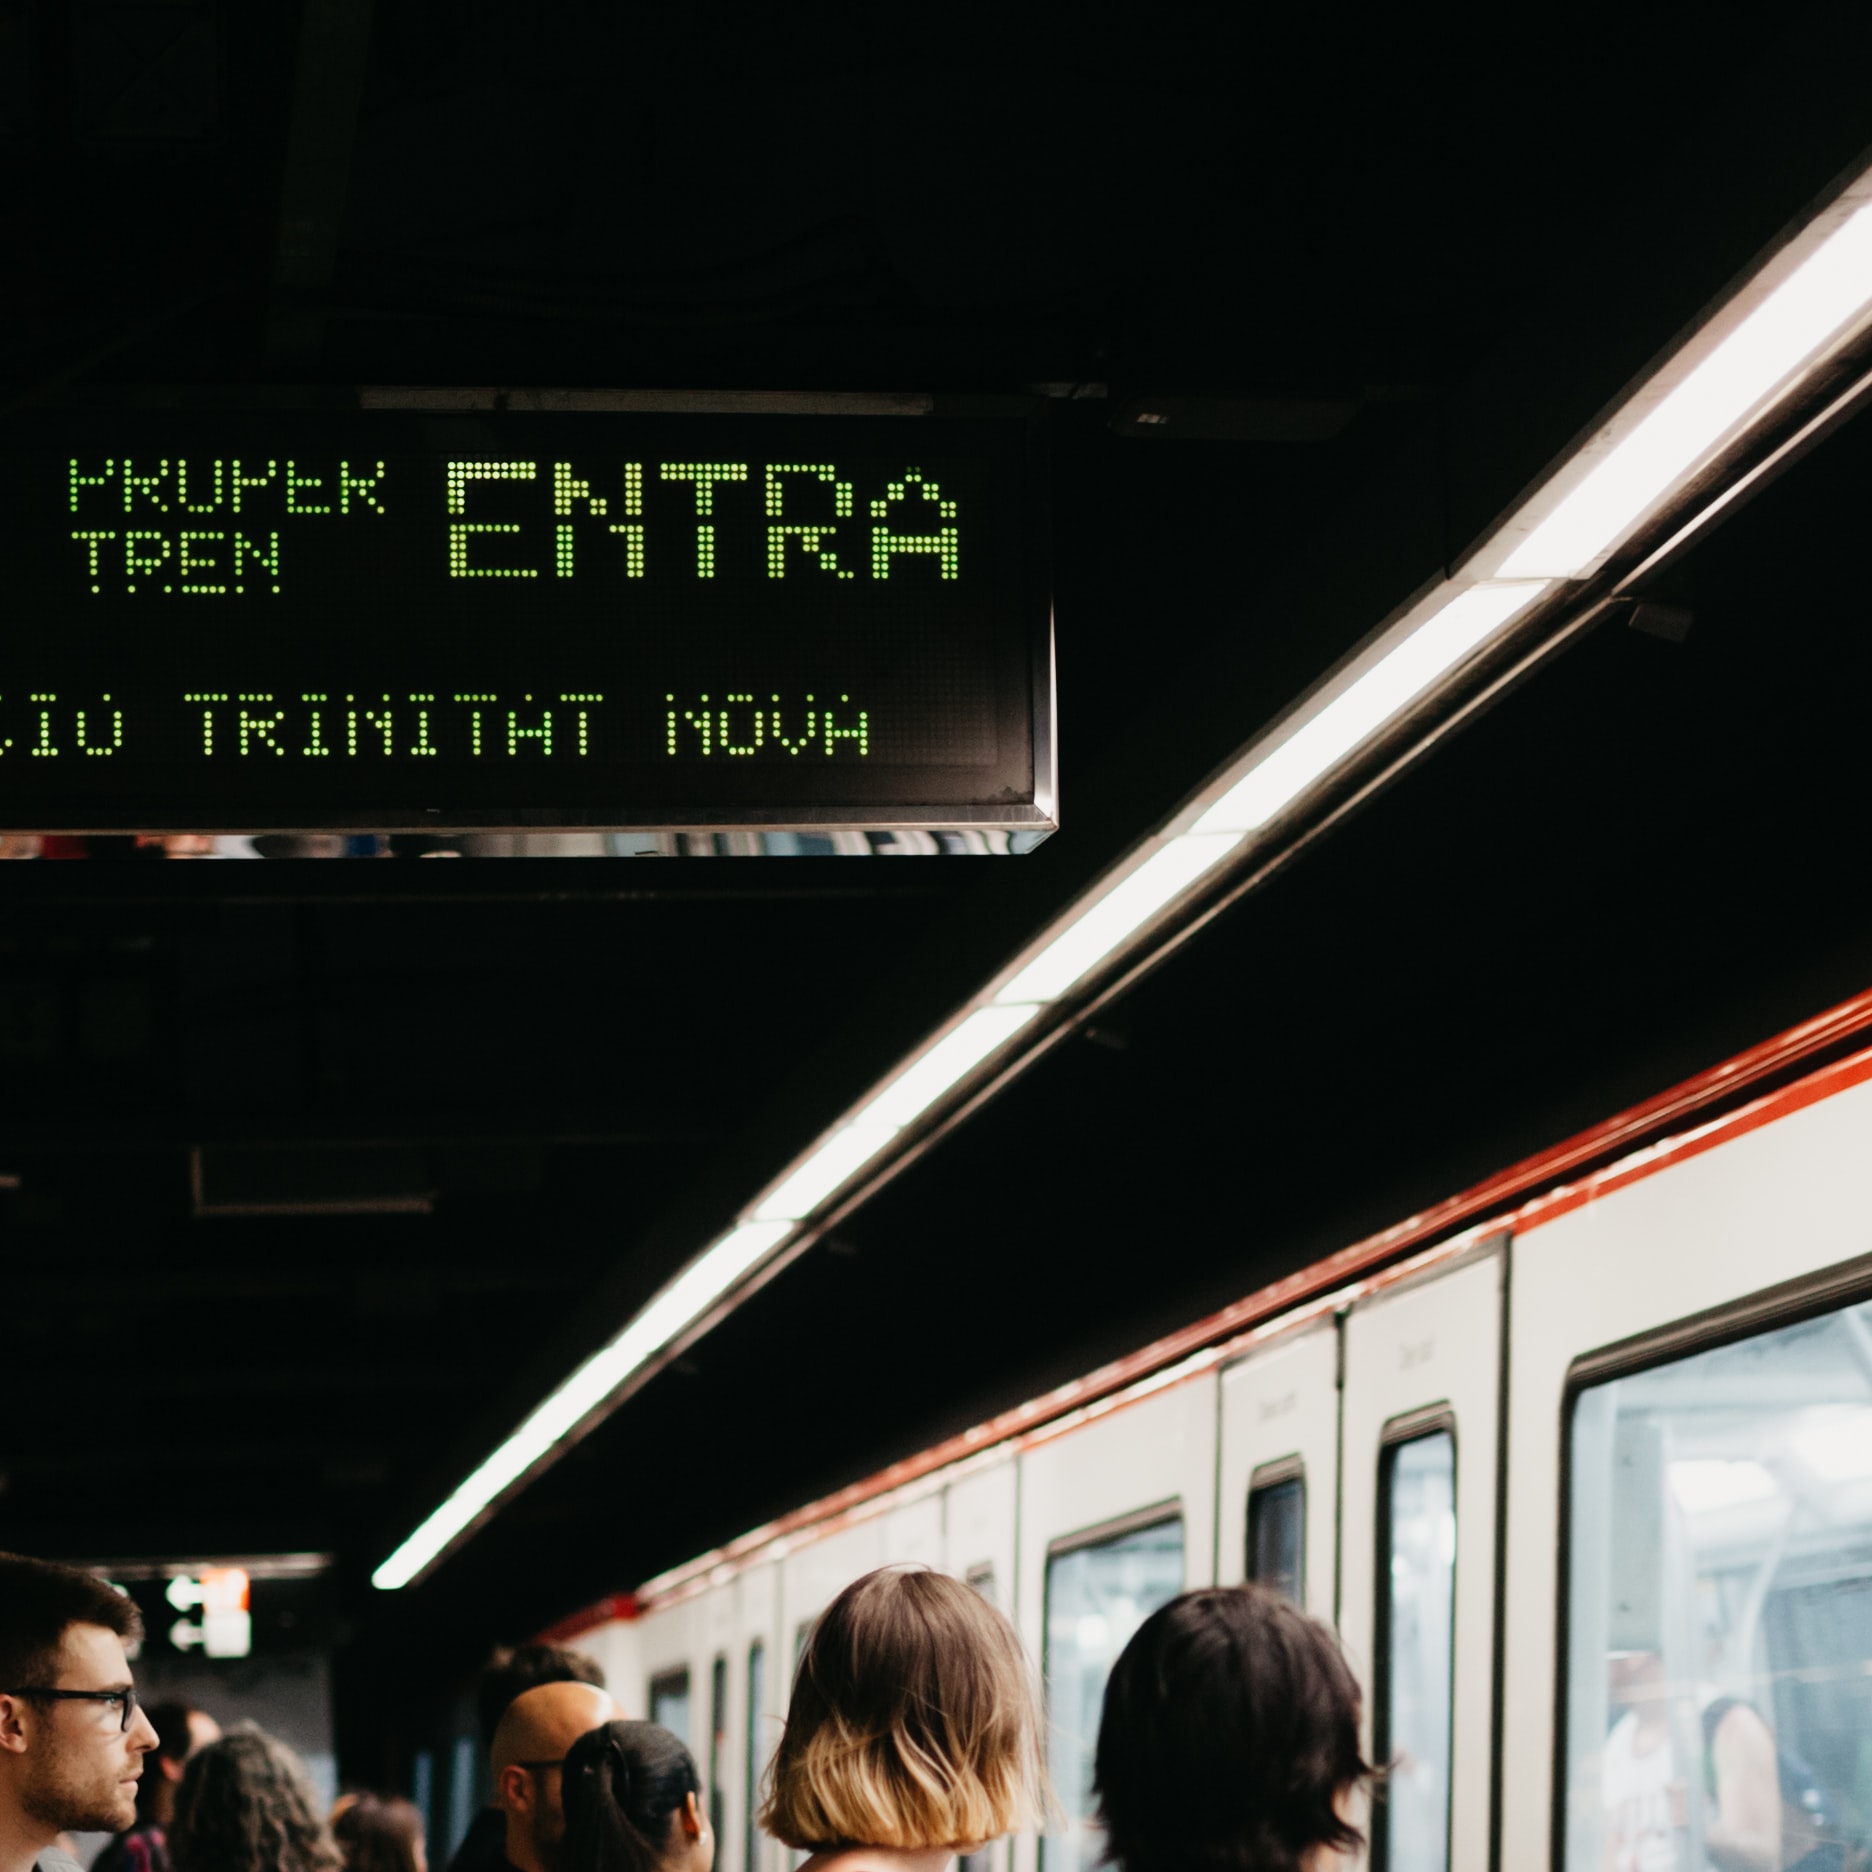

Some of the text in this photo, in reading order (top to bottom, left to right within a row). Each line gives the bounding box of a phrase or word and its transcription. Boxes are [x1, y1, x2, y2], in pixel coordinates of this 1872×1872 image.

[447, 462, 959, 580] ENTRA
[71, 531, 281, 594] TREN
[183, 693, 605, 757] TRINITAT
[664, 693, 869, 757] NOVA
